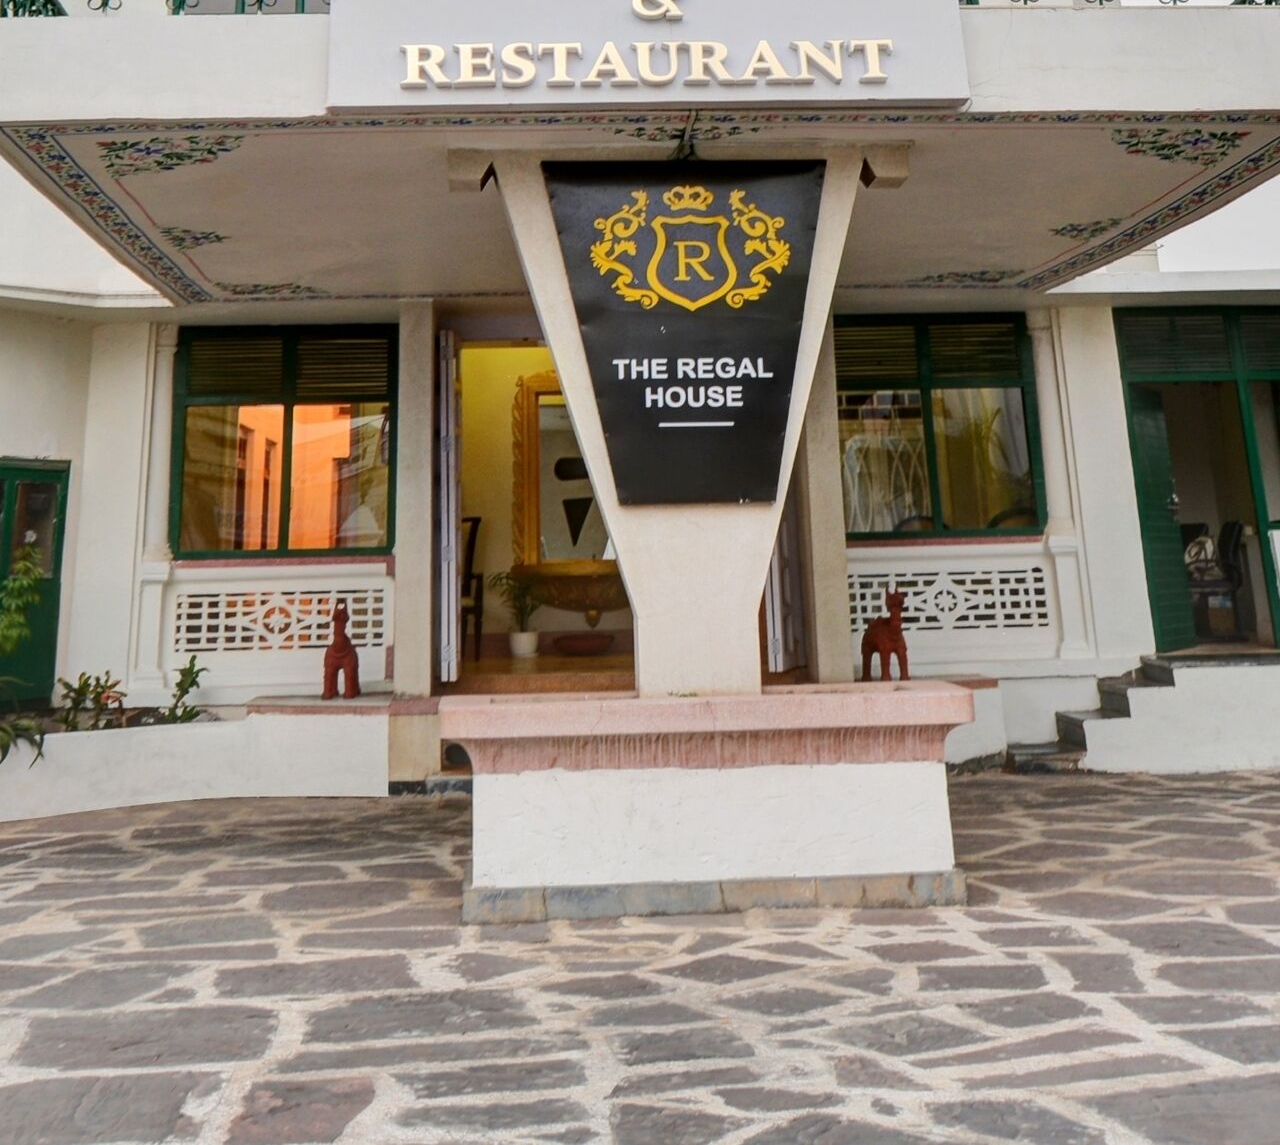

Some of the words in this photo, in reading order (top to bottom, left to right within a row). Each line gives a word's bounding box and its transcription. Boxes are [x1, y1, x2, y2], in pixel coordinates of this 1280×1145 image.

[400, 38, 894, 89] RESTAURANT
[673, 240, 715, 282] R
[612, 358, 668, 380] THE
[677, 357, 774, 379] REGAL
[645, 385, 744, 408] HOUSE
